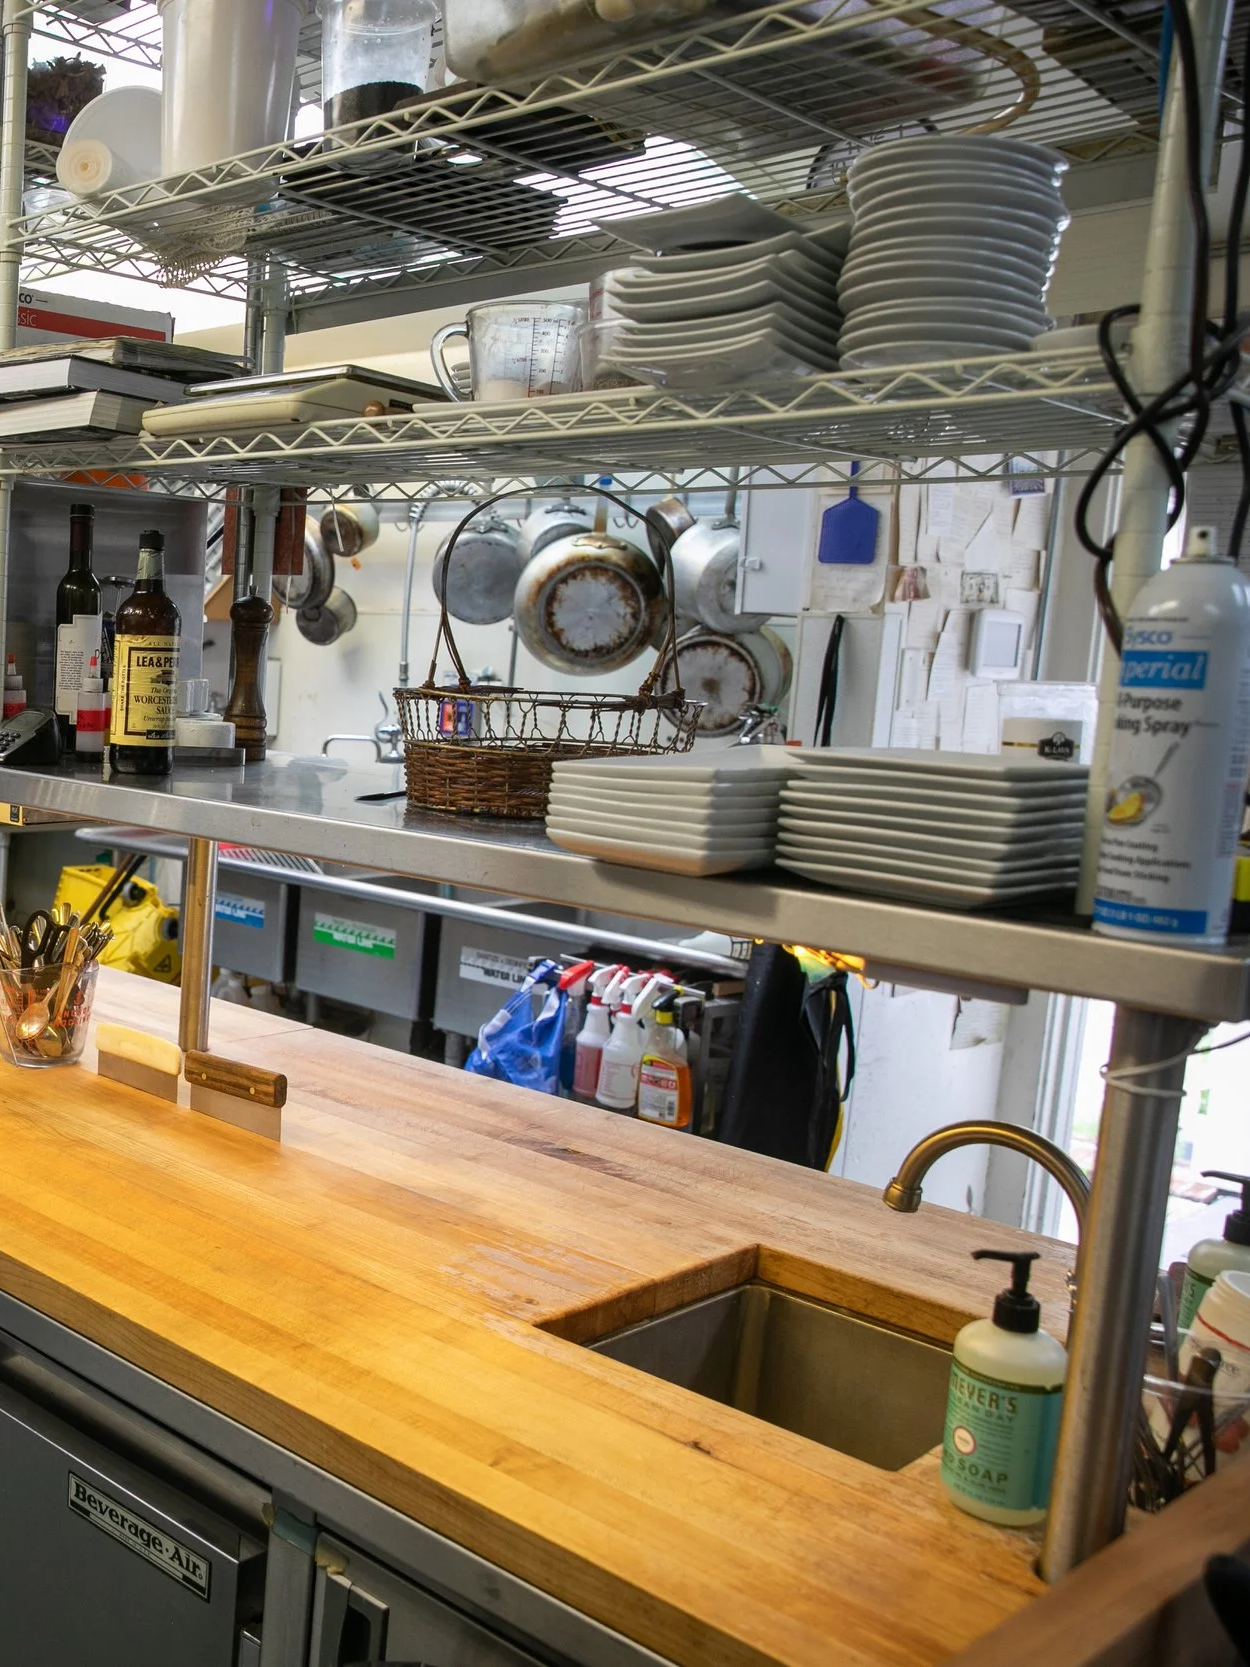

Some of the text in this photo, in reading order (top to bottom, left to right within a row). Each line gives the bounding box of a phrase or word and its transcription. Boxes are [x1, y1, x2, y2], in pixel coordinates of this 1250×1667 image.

[1122, 654, 1207, 684] perial
[1143, 715, 1192, 739] Spray
[483, 967, 526, 984] WATER LIN
[956, 1458, 1009, 1484] SOAP
